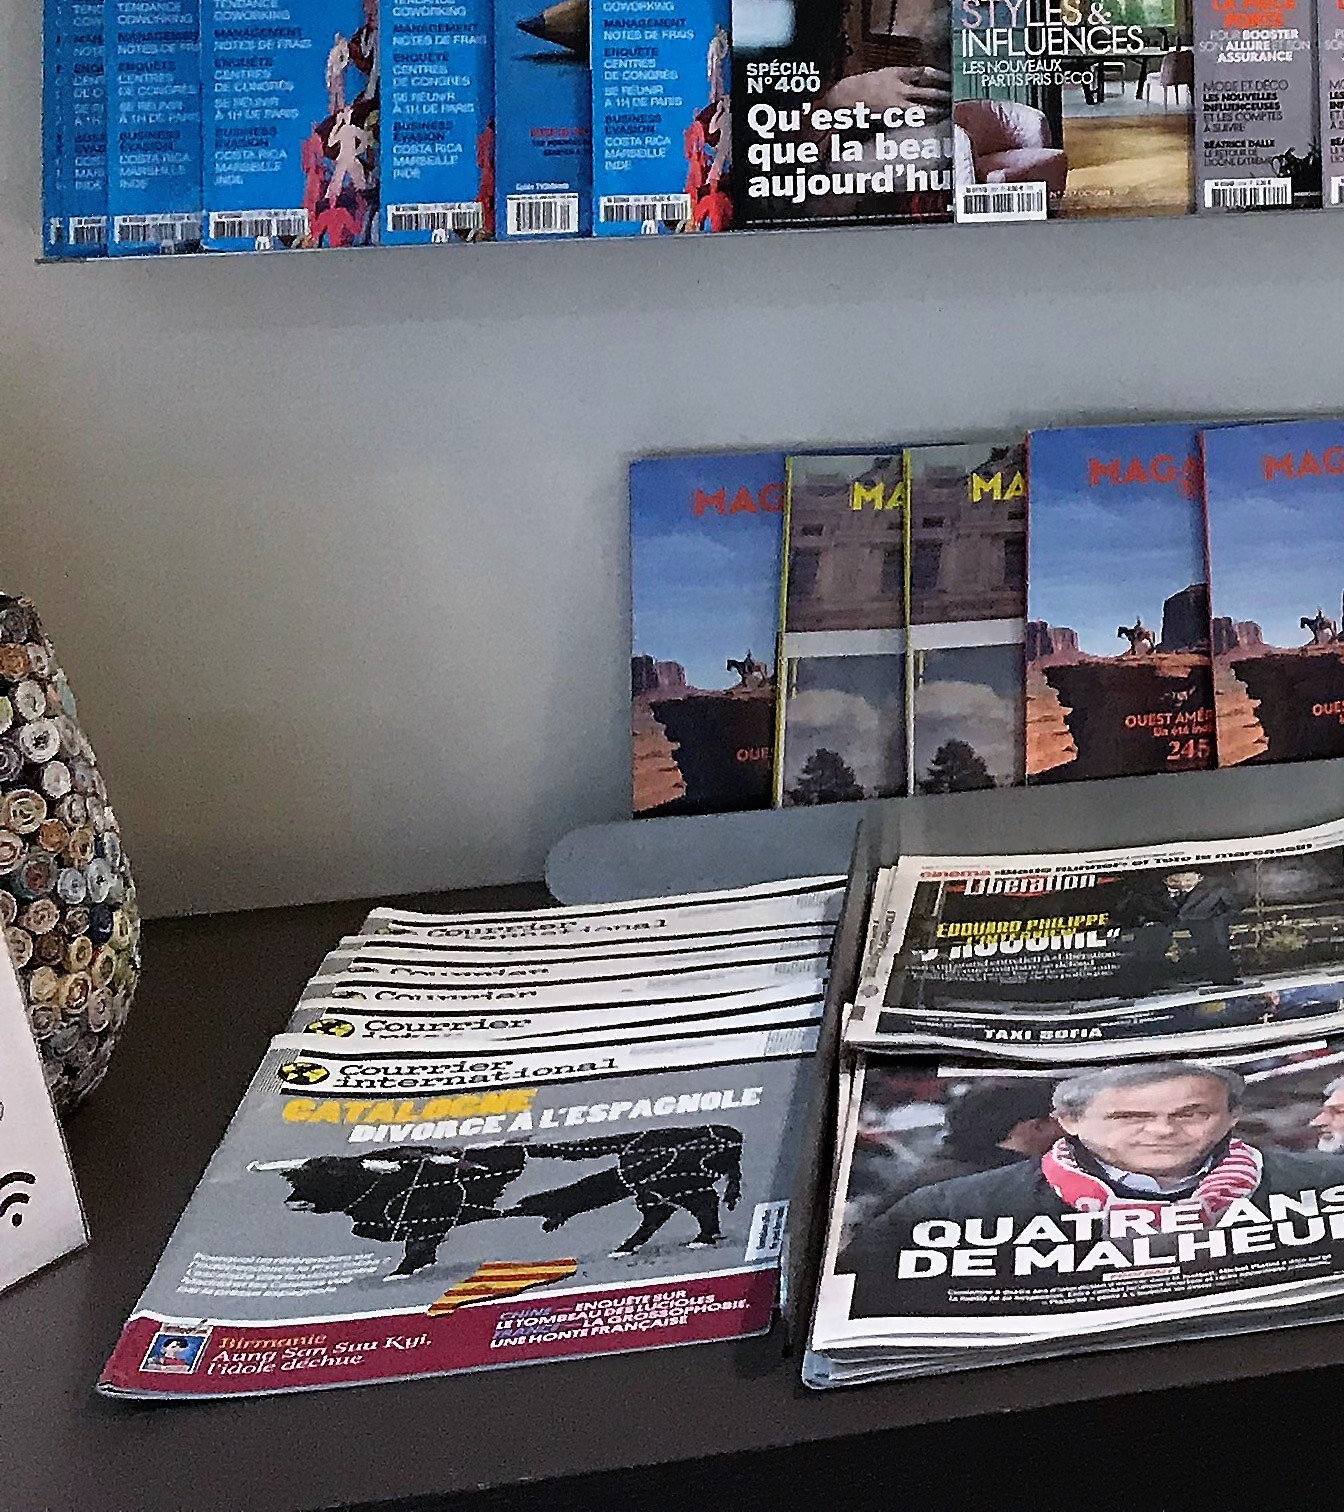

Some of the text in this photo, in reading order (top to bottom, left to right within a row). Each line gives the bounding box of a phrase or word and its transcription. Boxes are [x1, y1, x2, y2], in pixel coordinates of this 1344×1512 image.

[1088, 1, 1111, 26] &
[962, 25, 1144, 57] INFLUENCES
[746, 60, 820, 77] SPÉCIAL
[962, 59, 1062, 75] LES NOUVEAUX
[982, 72, 1023, 87] PARTIS
[1025, 72, 1052, 86] PRIS
[746, 75, 821, 94] N°400
[747, 134, 863, 172] que la
[1125, 712, 1173, 728] OUEST
[333, 1057, 620, 1089] international
[340, 1059, 514, 1078] Courrier
[281, 1089, 537, 1124] CATALOGNE
[348, 1115, 502, 1145] DIVORCE
[911, 1209, 1207, 1249] QUATRE
[897, 1249, 1000, 1280] DE
[212, 1351, 277, 1364] Aung
[332, 1341, 378, 1354] Suu
